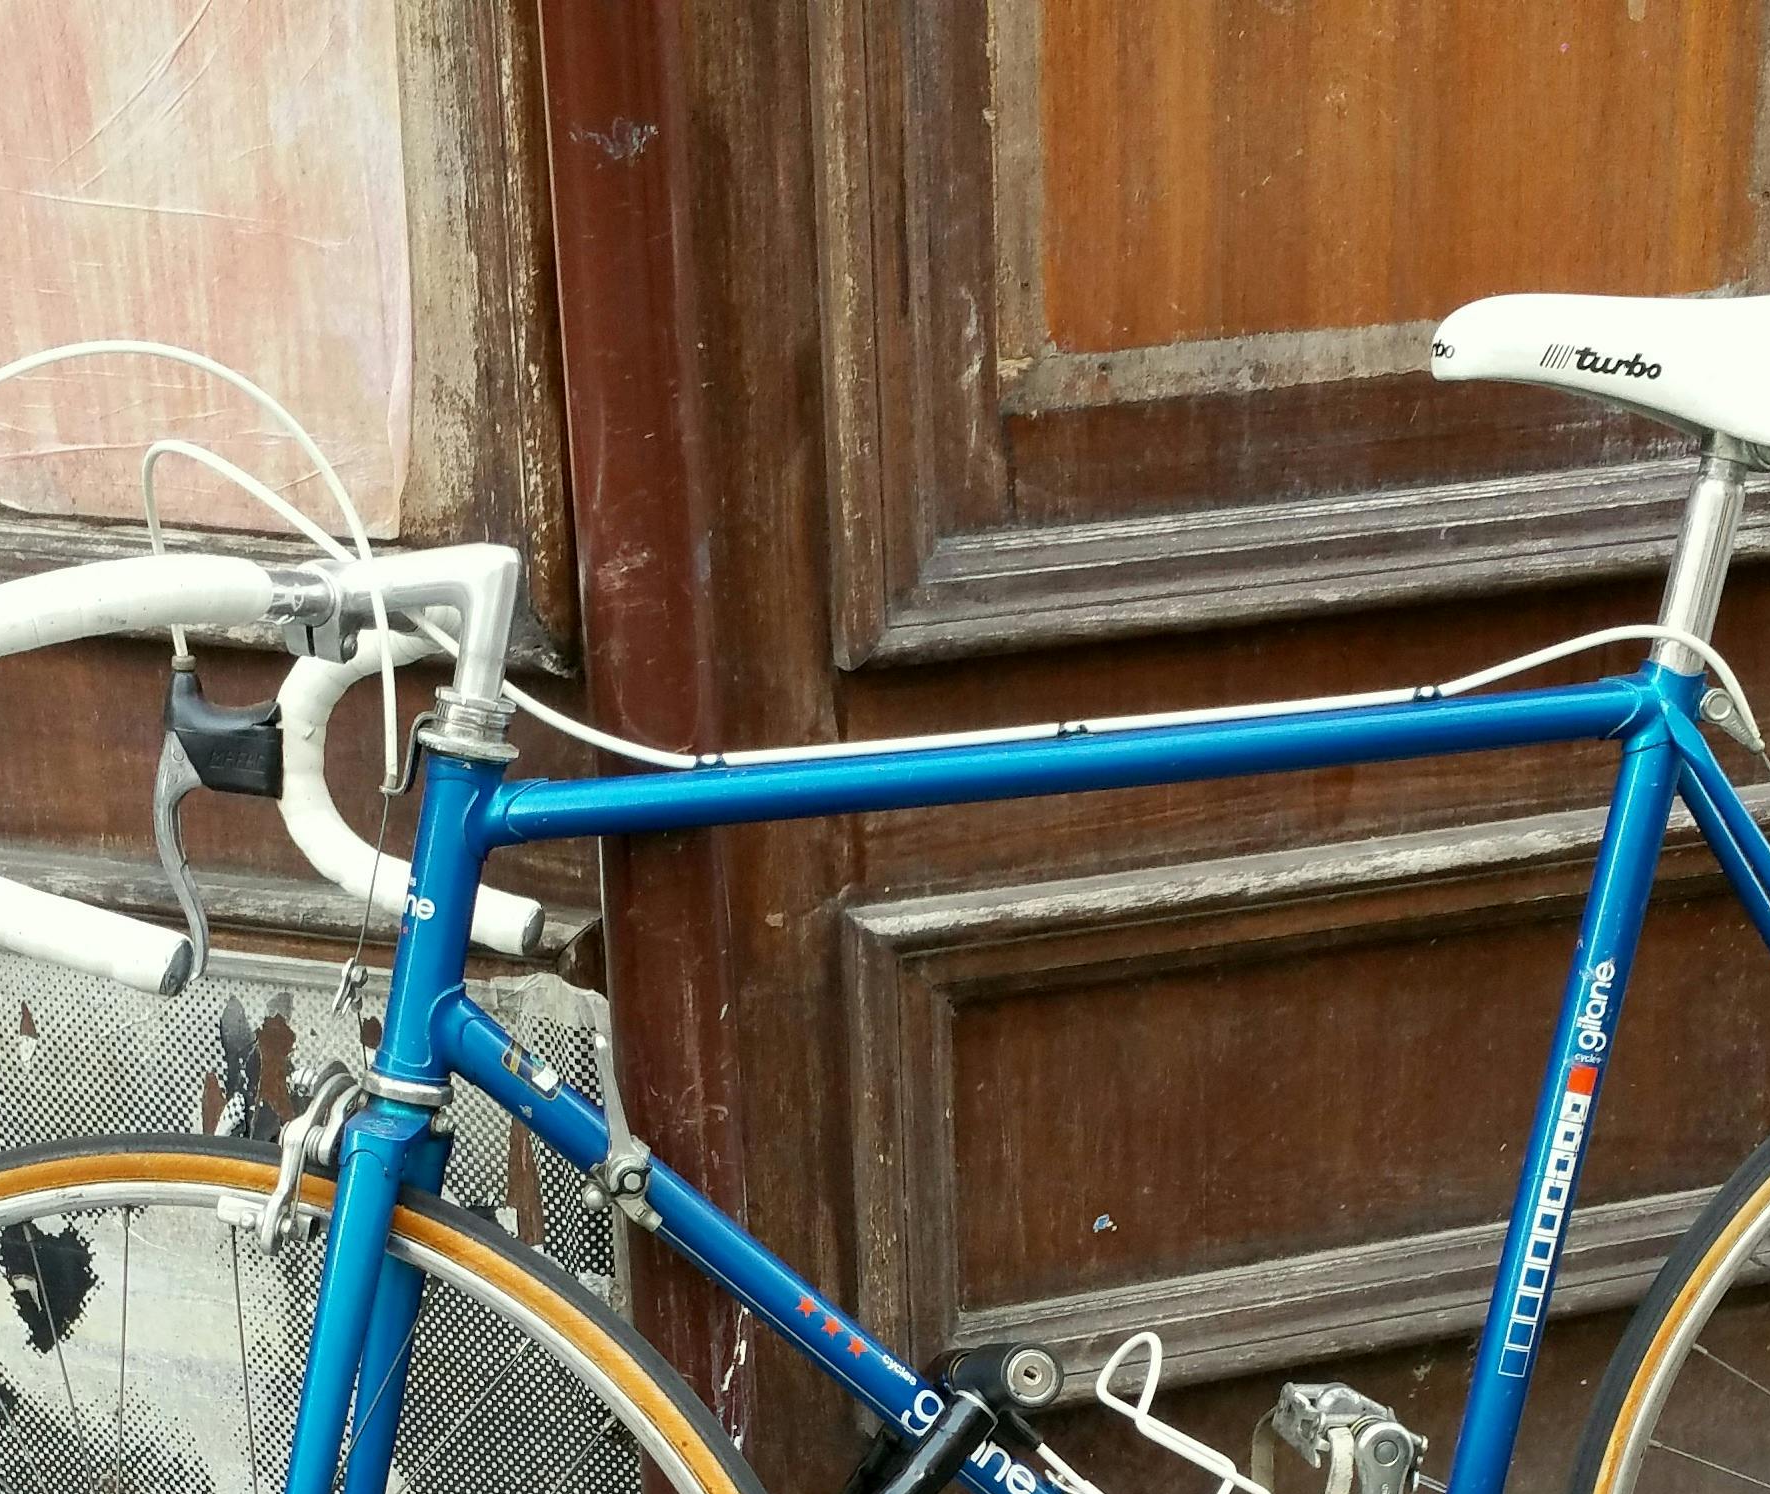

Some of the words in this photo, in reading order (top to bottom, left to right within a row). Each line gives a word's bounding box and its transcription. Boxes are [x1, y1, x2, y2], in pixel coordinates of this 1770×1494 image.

[1431, 339, 1455, 359] rbo
[1575, 347, 1662, 380] turbo
[1576, 960, 1616, 1053] gitane
[882, 1354, 917, 1386] cycles
